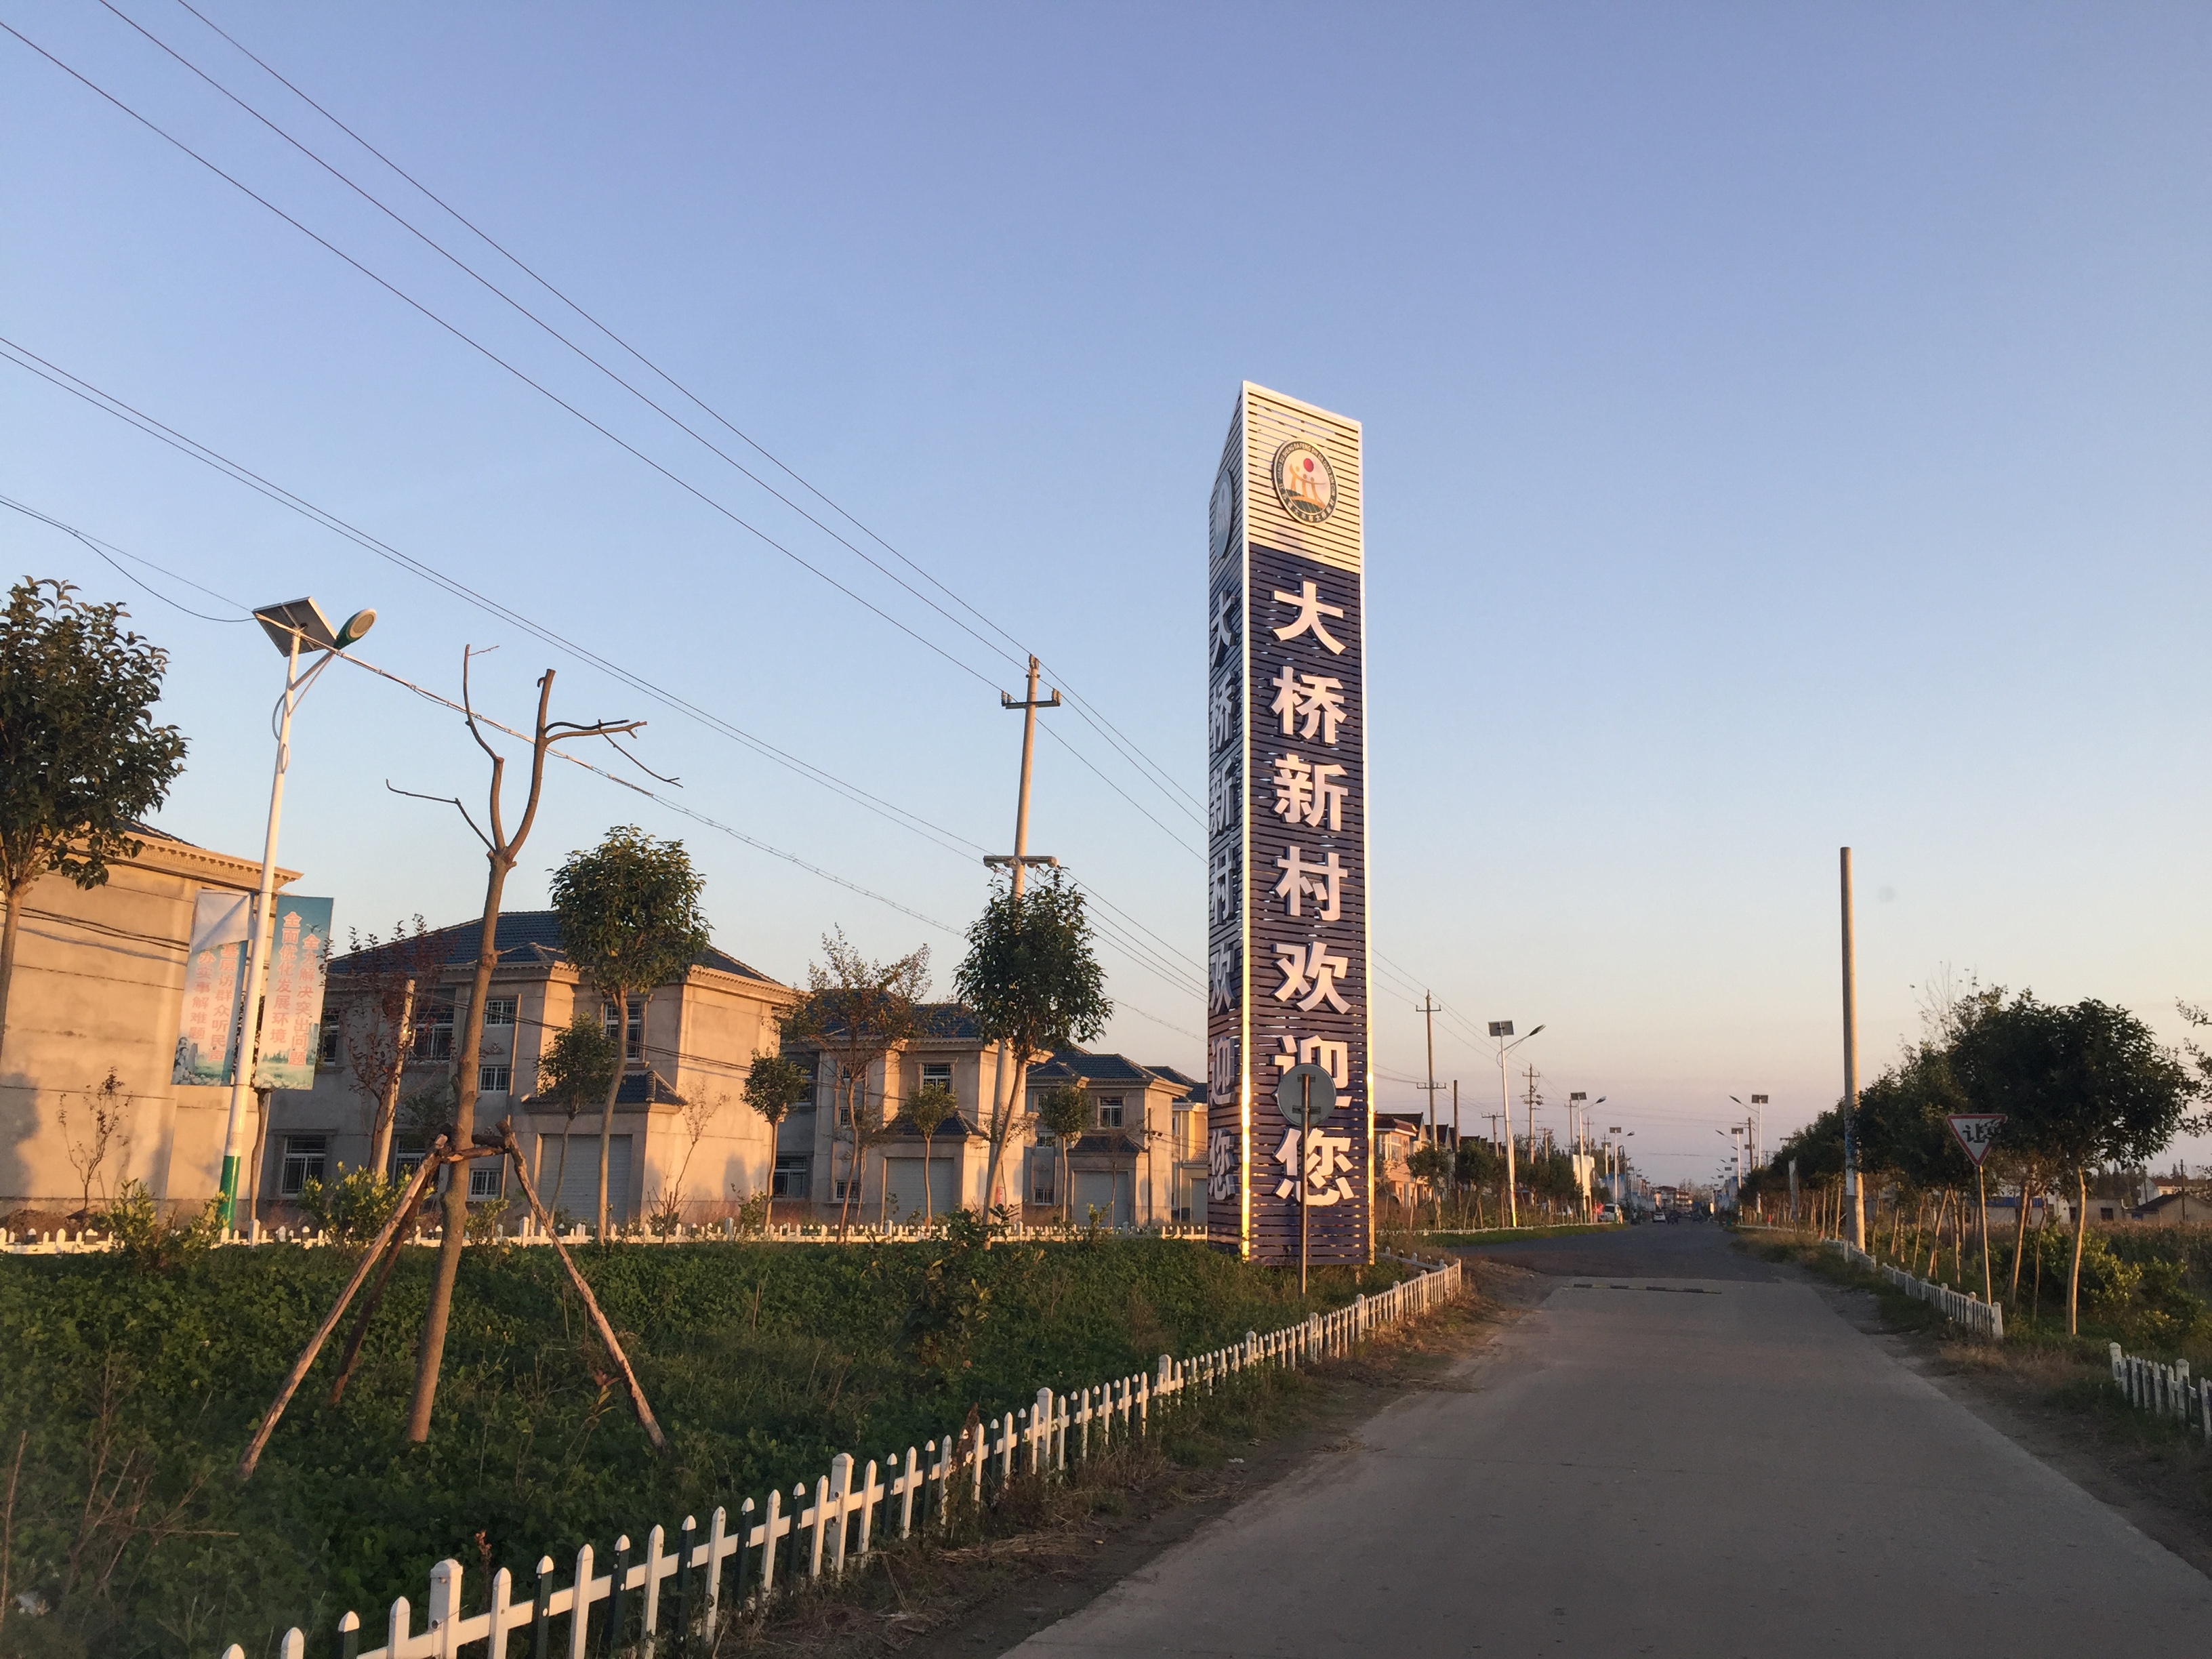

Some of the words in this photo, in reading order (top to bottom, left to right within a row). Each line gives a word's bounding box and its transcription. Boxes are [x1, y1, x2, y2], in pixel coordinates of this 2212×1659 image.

[1208, 590, 1236, 1200] 大桥新村欢迎您
[188, 950, 216, 1040] 办实事解难题
[270, 911, 302, 1044] 全面优化发展环境
[288, 934, 321, 1067] 全力解决突出问题
